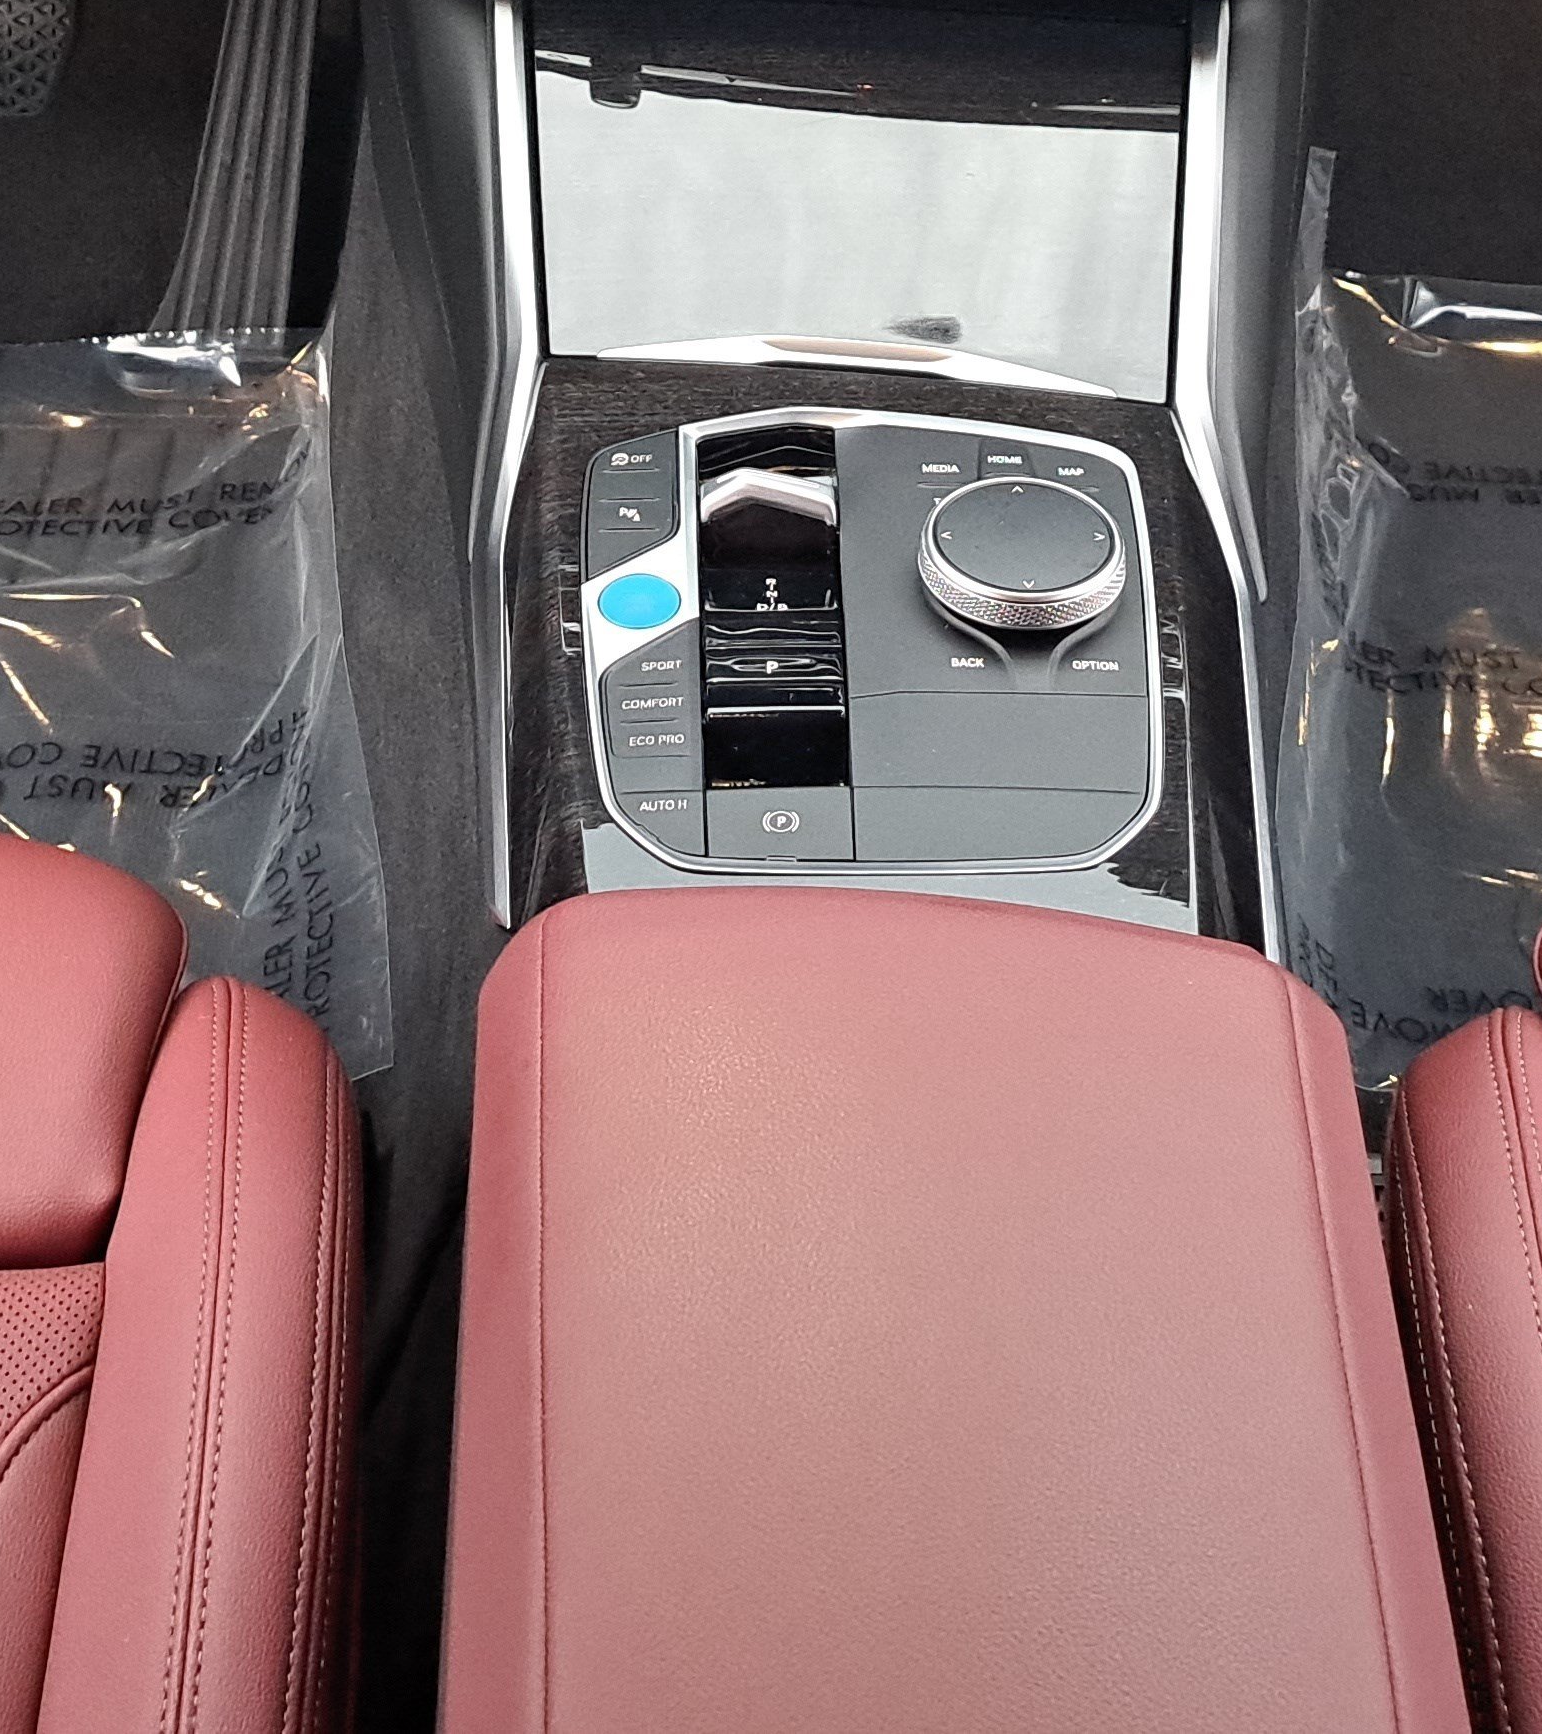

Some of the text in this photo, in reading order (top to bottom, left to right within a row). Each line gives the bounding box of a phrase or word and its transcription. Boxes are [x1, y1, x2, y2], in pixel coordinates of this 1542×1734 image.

[631, 454, 652, 463] OFF
[987, 455, 1022, 464] HOME
[922, 464, 960, 474] MEDIA
[1058, 467, 1084, 476] MAP
[107, 488, 197, 515] MUST
[641, 660, 682, 672] SPORT
[766, 660, 779, 674] P
[951, 657, 985, 668] BACK
[1072, 660, 1119, 671] OPTION
[622, 697, 684, 710] COMFORT
[629, 734, 685, 747] ECO PRO
[640, 799, 687, 812] AUTO H
[297, 841, 334, 1017] ROTECTIVE
